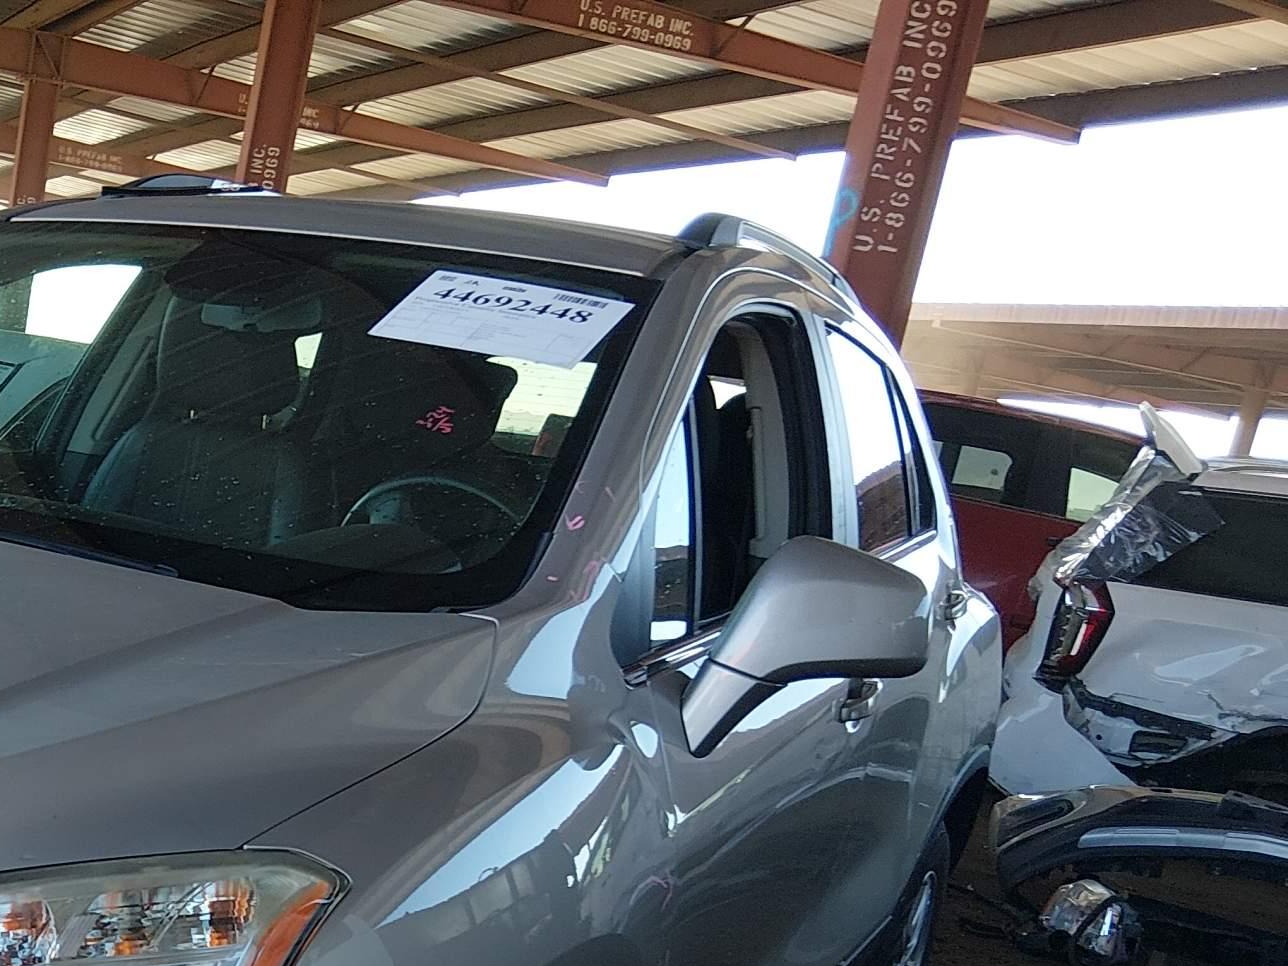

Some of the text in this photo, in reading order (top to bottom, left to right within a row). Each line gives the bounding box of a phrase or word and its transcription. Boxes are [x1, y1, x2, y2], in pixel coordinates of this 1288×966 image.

[580, 0, 694, 36] U.S. PREFAB INC.
[877, 0, 958, 253] 1-866-799-0969
[249, 144, 267, 174] INC.
[853, 199, 884, 252] U.S.
[871, 65, 916, 180] PREFAB
[433, 287, 593, 323] 44692448
